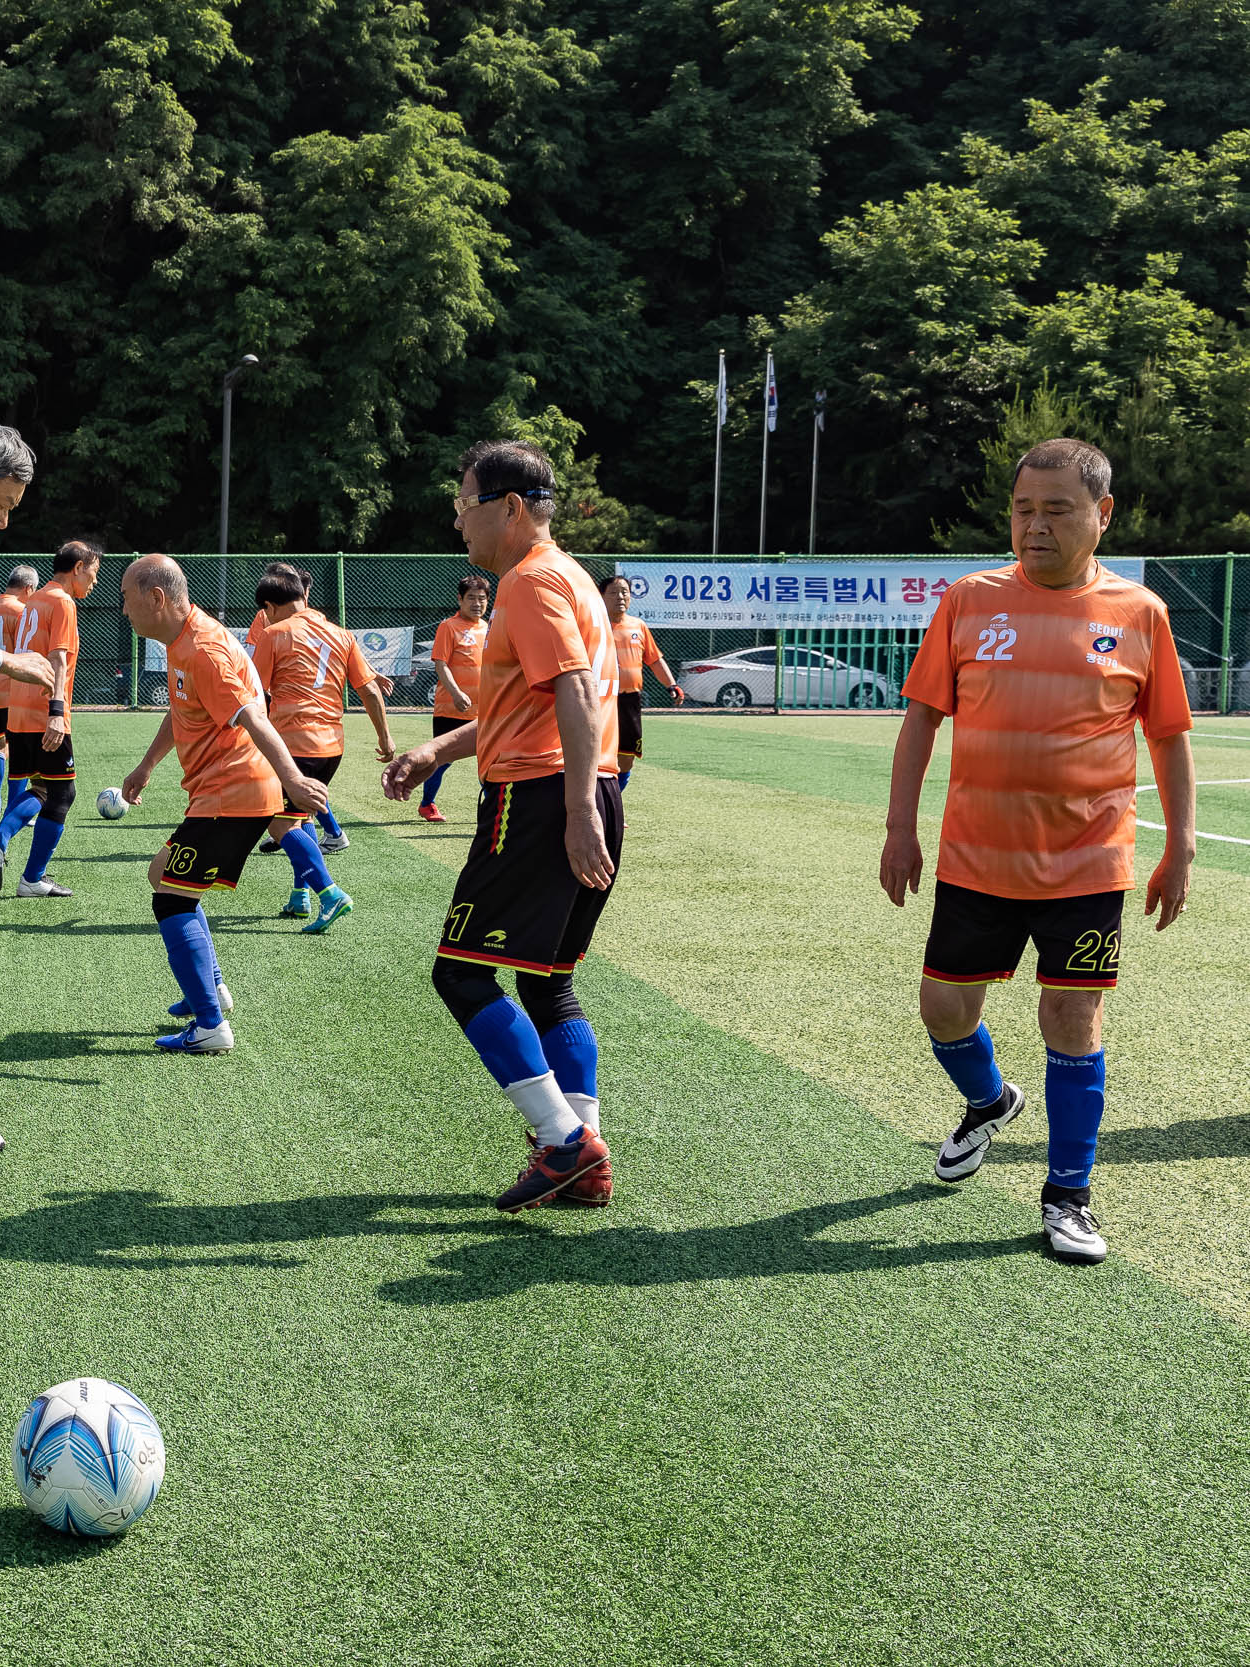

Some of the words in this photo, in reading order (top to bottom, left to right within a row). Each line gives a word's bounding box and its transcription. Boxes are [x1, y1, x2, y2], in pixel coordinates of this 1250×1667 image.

[664, 575, 732, 601] 2023
[746, 576, 886, 603] 서울특별시
[13, 607, 39, 654] 12
[664, 610, 684, 620] 2023년
[1088, 622, 1126, 640] SEOUL
[975, 628, 1017, 661] 22
[306, 635, 332, 689] 7
[165, 842, 198, 875] 18
[1066, 929, 1119, 971] 22
